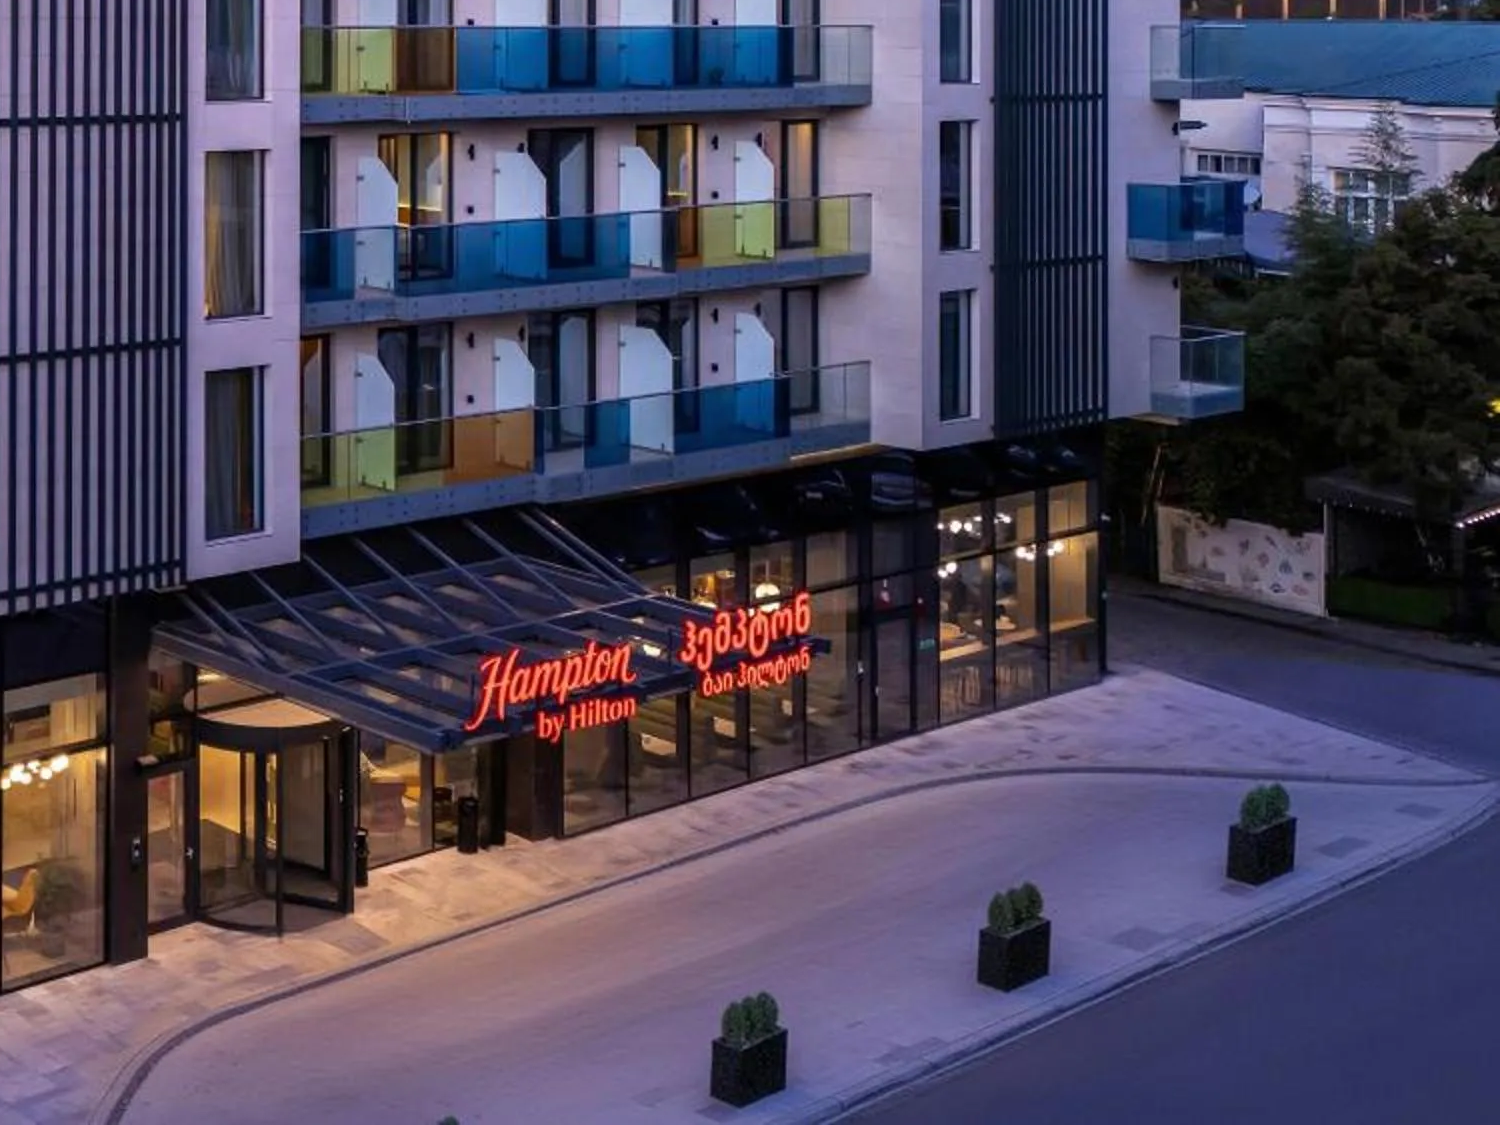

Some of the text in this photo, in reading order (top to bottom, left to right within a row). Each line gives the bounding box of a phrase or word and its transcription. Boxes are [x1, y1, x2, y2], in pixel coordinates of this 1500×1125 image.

[680, 591, 812, 672] ჰემპტონ
[464, 640, 637, 732] Hampton
[703, 645, 811, 697] ბაი ჰილტონ
[537, 695, 637, 744] by Hilton
